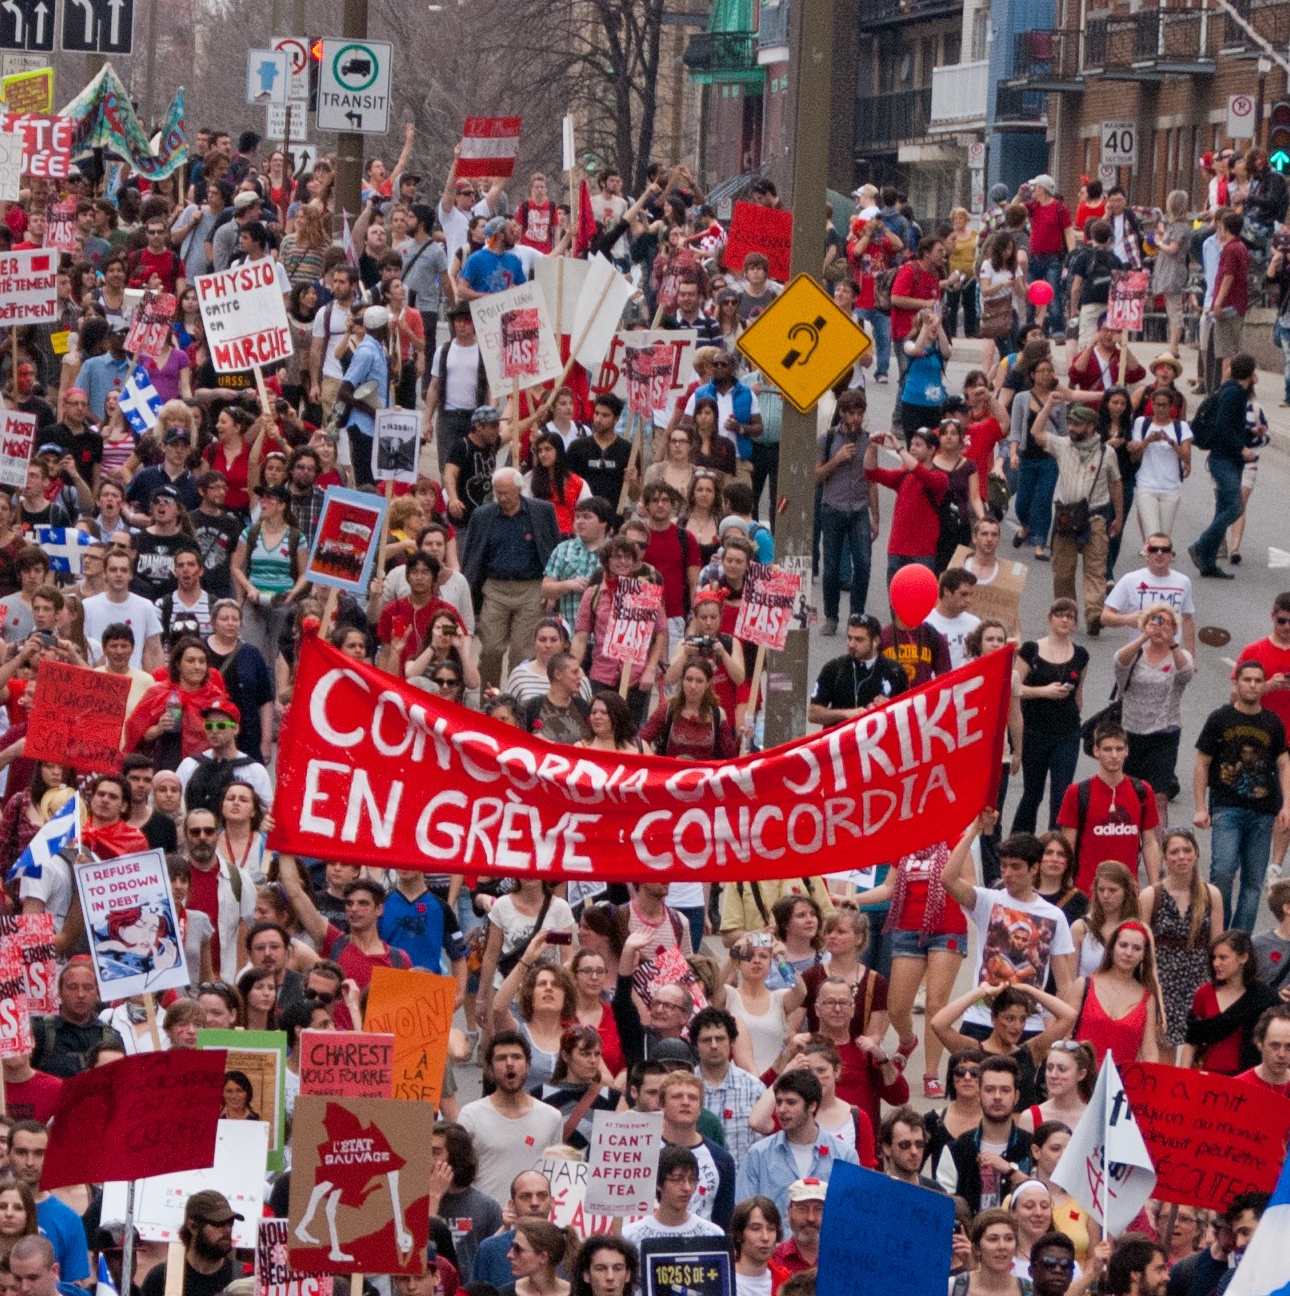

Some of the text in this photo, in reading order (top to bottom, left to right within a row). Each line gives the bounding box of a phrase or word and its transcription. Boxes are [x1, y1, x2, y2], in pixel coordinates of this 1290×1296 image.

[322, 93, 385, 110] TRANSIT
[1105, 131, 1133, 153] 40
[200, 263, 274, 300] PHYSIO
[309, 667, 987, 801] CONCORDIA ON STRIKE
[299, 759, 958, 872] EN GRÈVE CONCORDIA
[1094, 824, 1138, 835] adidas
[94, 862, 140, 880] REFUSE
[89, 875, 158, 897] TO DROWN
[91, 894, 140, 912] IN DEBT
[311, 1043, 391, 1066] CHAREST
[301, 1068, 391, 1085] VOUS FOURRE
[607, 1134, 653, 1147] CAN'T
[325, 1151, 390, 1166] SAUVAGE
[603, 1151, 641, 1163] EVEN
[592, 1167, 651, 1179] AFFORD
[607, 1184, 635, 1196] TEA
